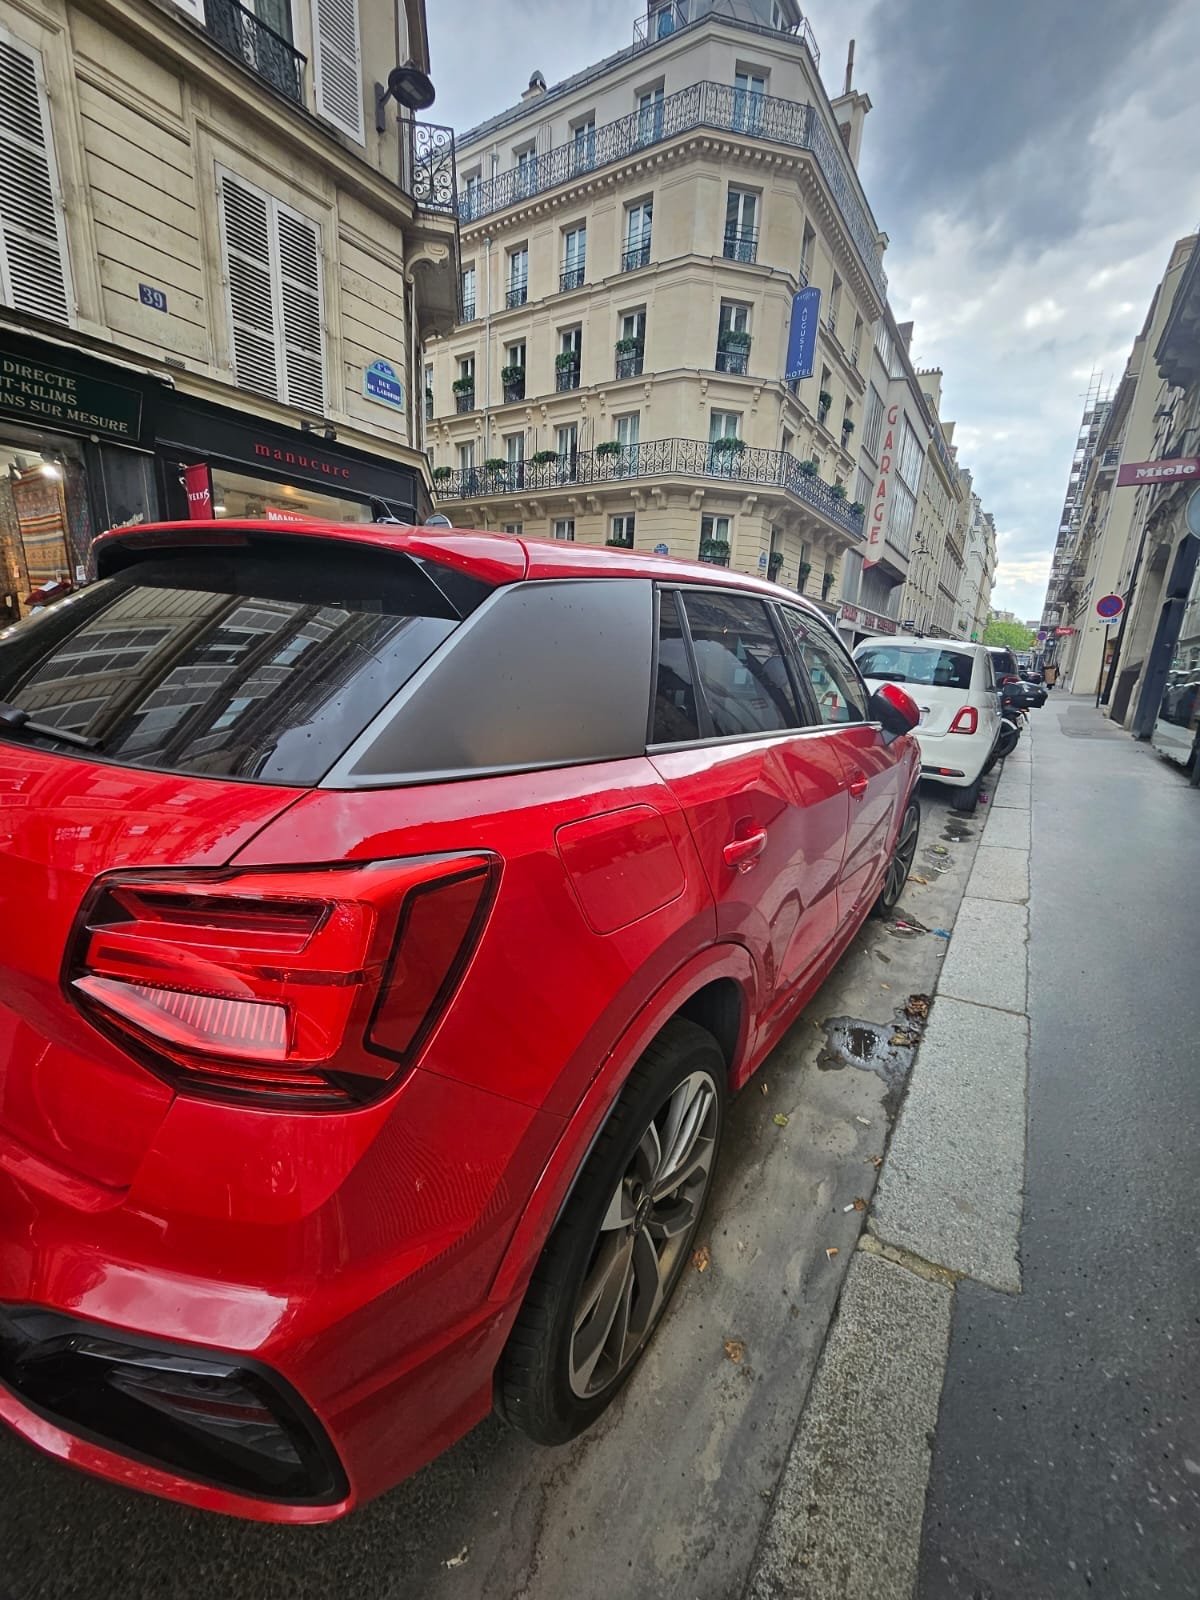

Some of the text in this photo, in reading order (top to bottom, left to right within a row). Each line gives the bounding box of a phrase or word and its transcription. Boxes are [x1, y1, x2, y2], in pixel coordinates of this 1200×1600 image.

[143, 287, 163, 308] 39
[796, 307, 808, 367] AUGUSTIN
[3, 360, 77, 391] DIRECTE
[785, 368, 811, 379] HOTEL
[30, 399, 63, 417] SUR
[67, 408, 128, 434] MESURE
[254, 443, 351, 479] manucure
[869, 404, 899, 545] GARAGE
[1135, 465, 1196, 479] Miele
